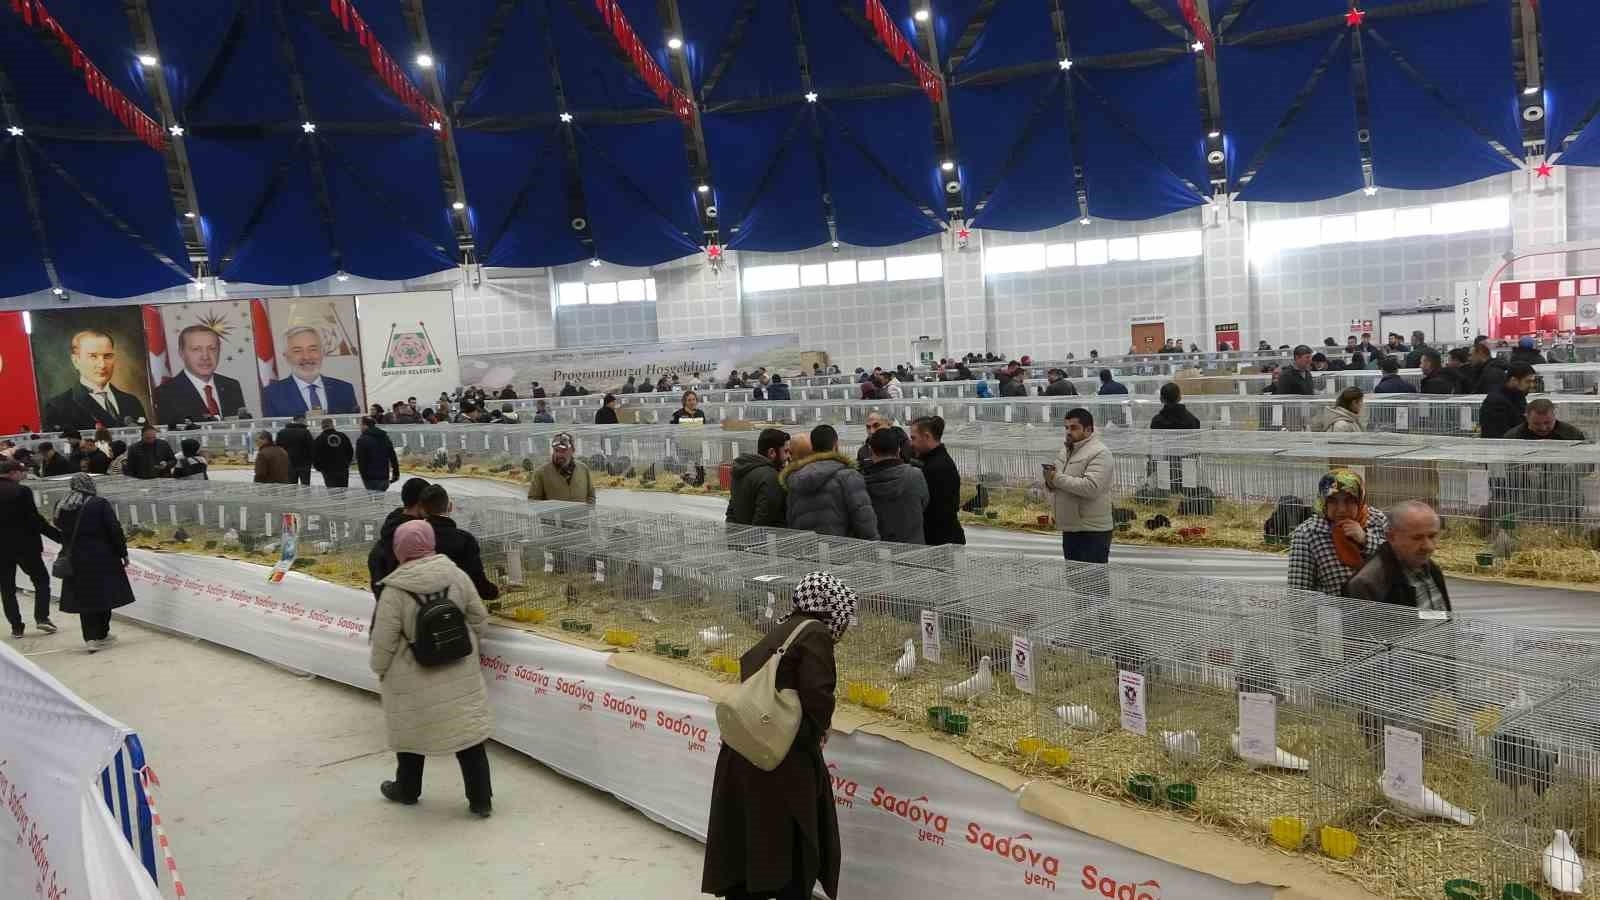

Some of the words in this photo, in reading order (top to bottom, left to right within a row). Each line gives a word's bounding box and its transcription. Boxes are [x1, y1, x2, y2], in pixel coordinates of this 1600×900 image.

[629, 719, 646, 731] yem
[687, 738, 706, 752] yem
[918, 828, 945, 847] yem
[1024, 869, 1056, 892] yem
